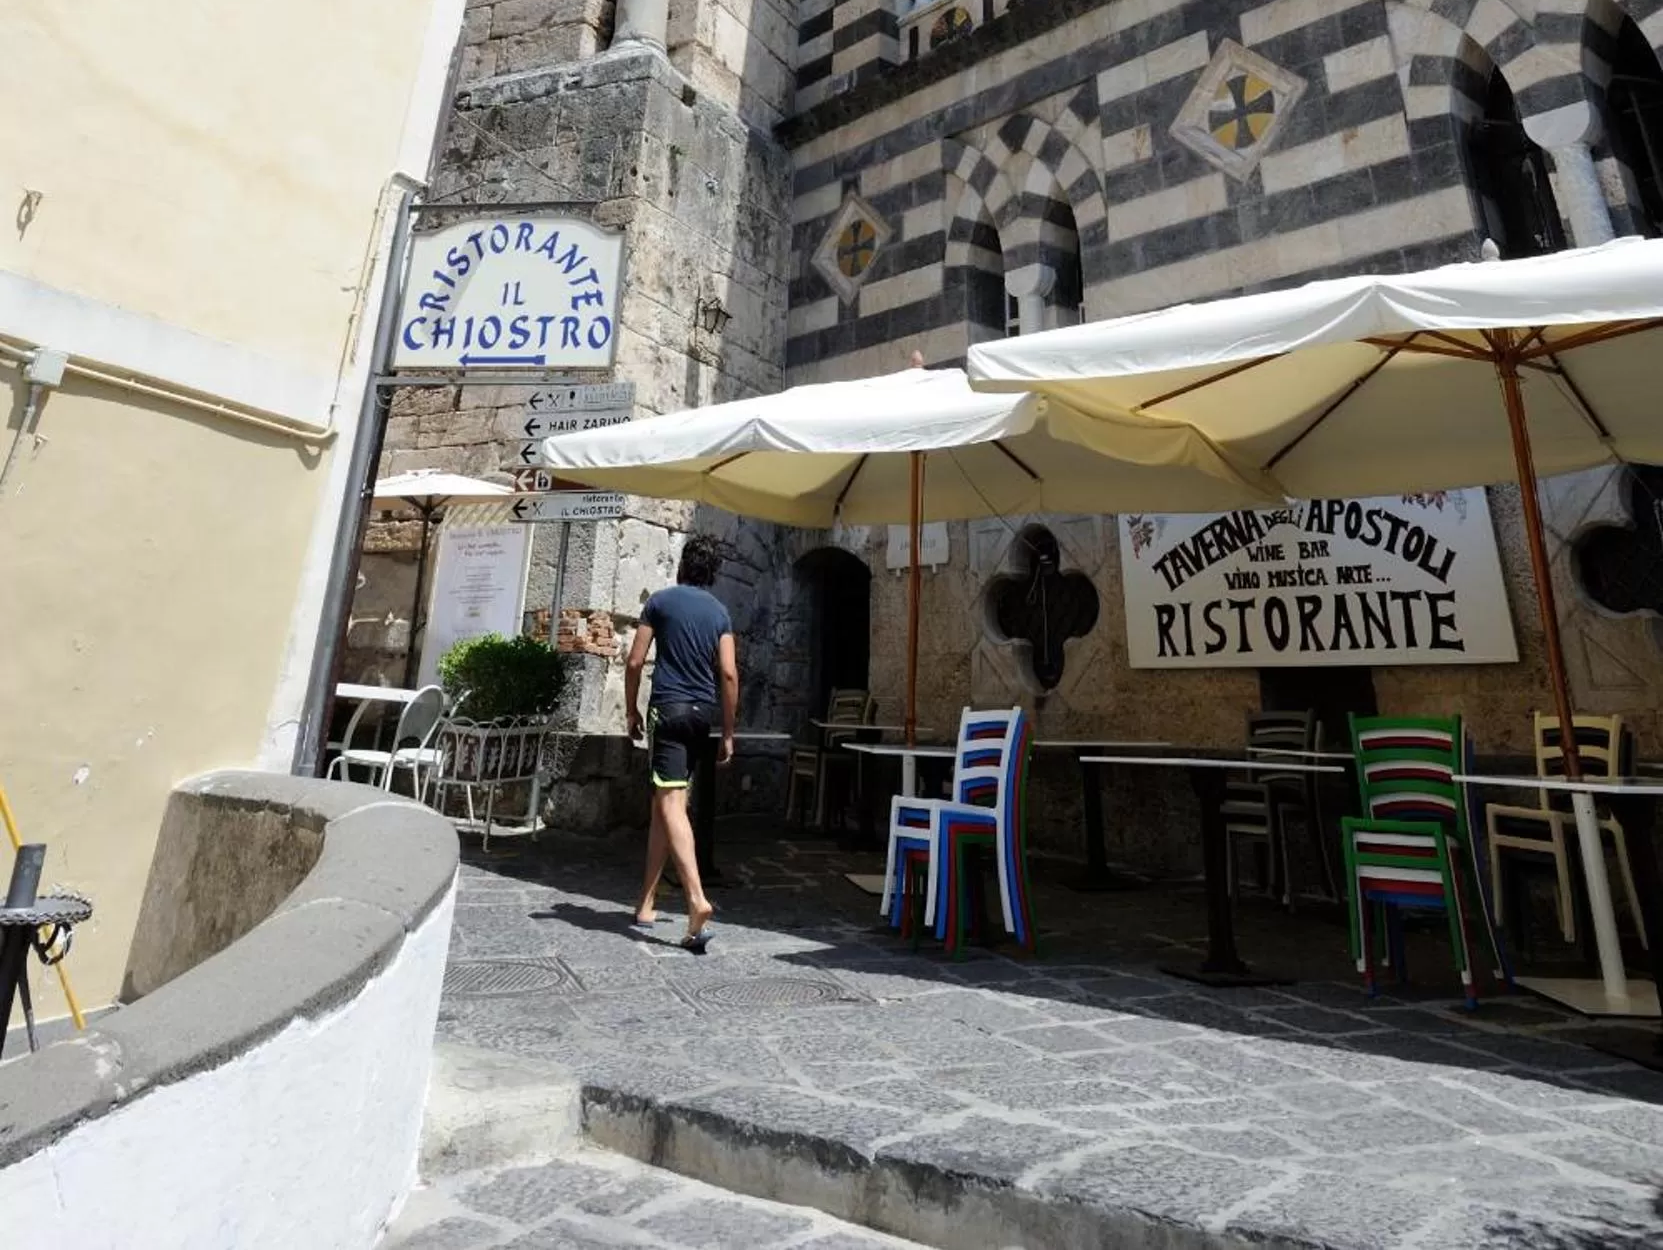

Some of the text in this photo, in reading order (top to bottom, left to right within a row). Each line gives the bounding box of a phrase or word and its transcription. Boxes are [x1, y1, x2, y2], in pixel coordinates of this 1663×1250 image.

[419, 222, 604, 312] RISTORANTE
[502, 281, 526, 306] IL
[403, 315, 611, 351] CHIOSTRO
[549, 419, 578, 431] HAIR
[572, 505, 622, 516] CHIOSTRO
[1152, 509, 1266, 591] TAVERNA
[1305, 499, 1457, 584] APOSTOLI
[1298, 540, 1330, 559] BAR
[1153, 590, 1466, 658] RISTORANTE
